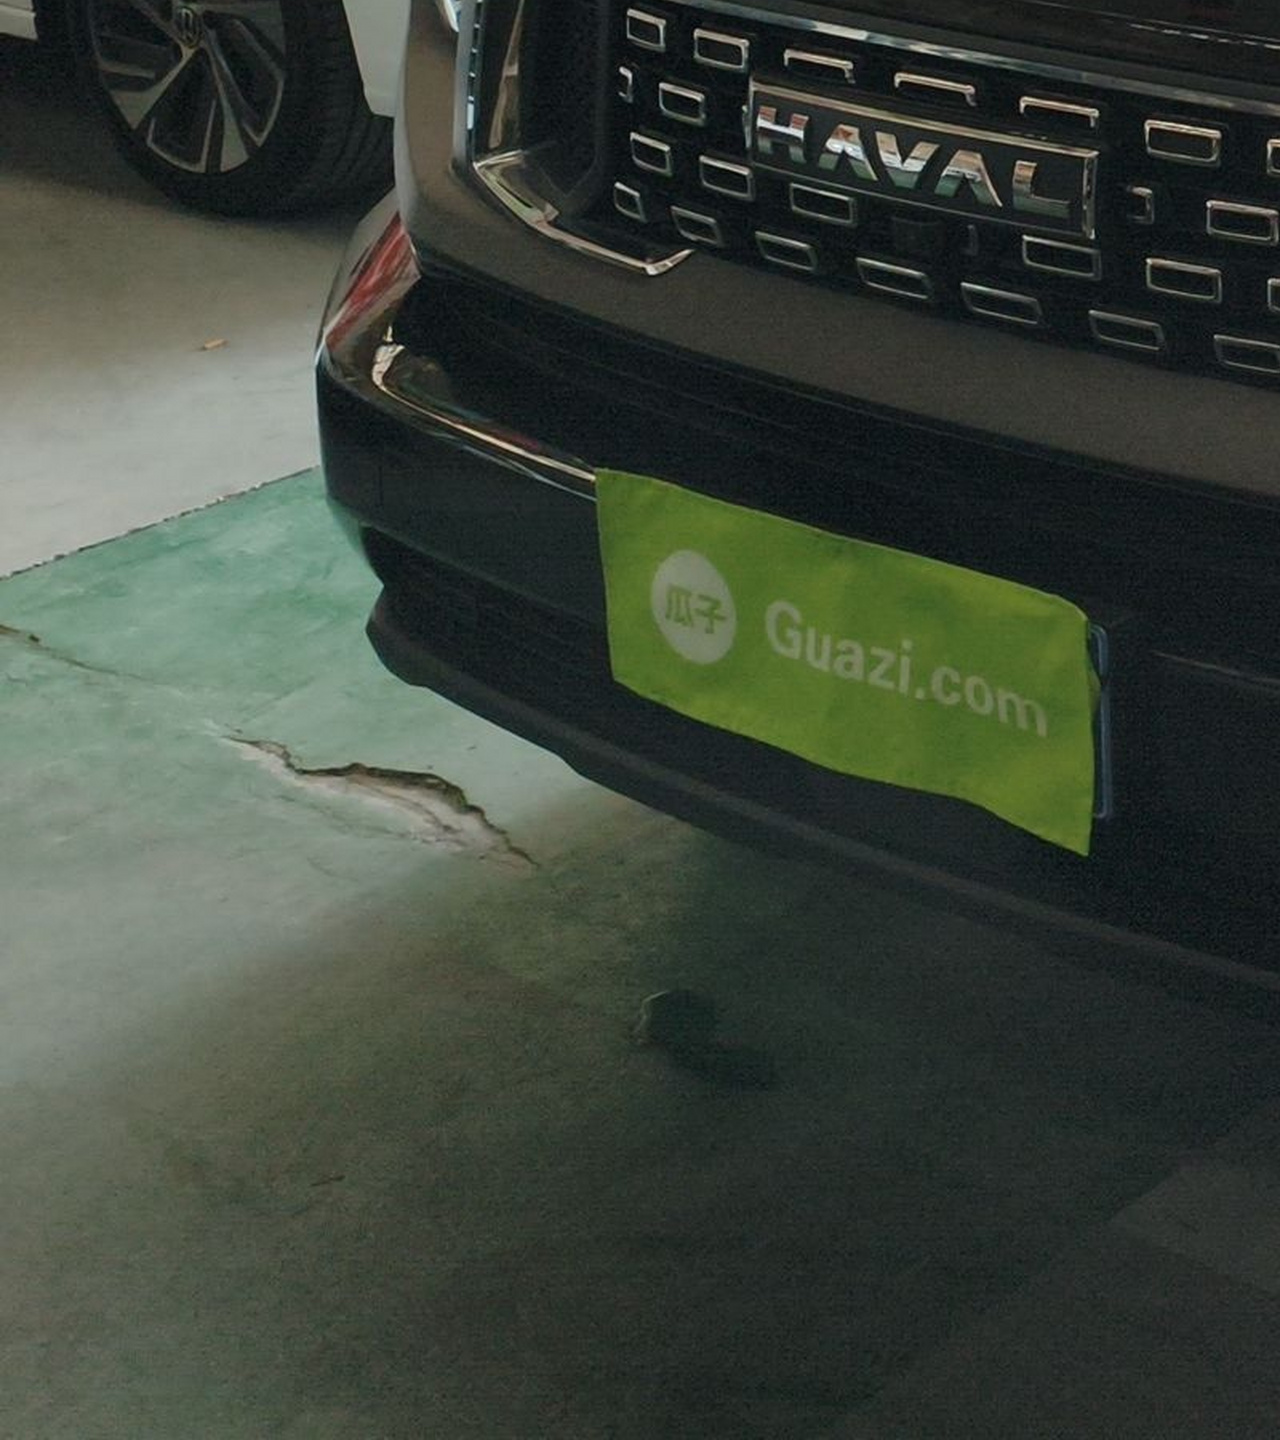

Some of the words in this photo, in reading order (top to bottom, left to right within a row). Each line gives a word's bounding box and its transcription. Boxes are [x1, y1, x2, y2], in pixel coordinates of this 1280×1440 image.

[756, 106, 1071, 216] HAVAL
[664, 582, 727, 634] 瓜子
[765, 600, 1048, 738] Guazi.com
